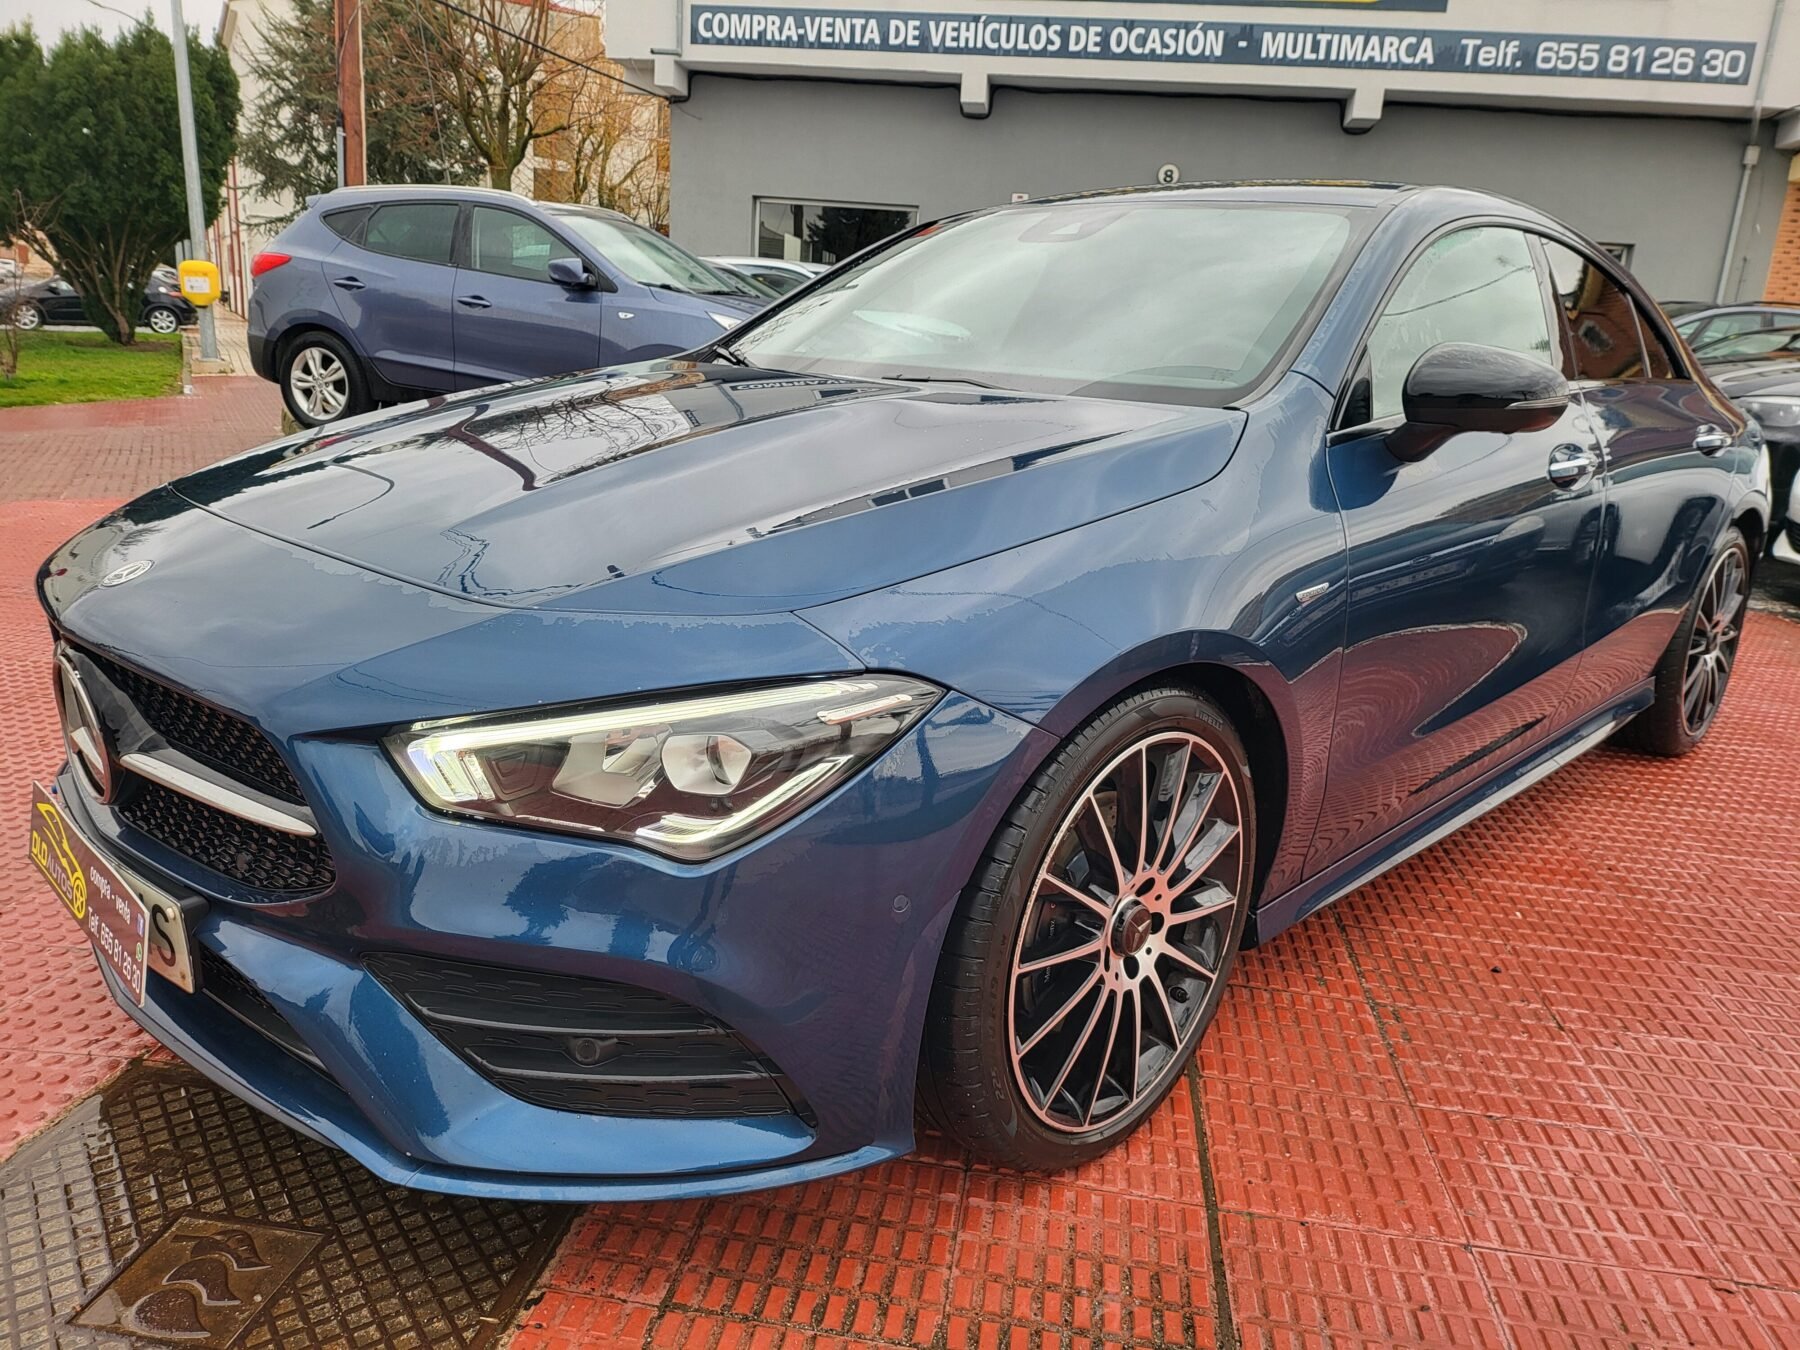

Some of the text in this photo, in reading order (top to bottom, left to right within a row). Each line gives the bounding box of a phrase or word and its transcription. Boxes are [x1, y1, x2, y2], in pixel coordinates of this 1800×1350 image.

[698, 11, 880, 45] COMPRA-VENTA
[888, 20, 919, 47] DE
[929, 15, 1061, 52] VEHÍCULOS
[1068, 25, 1101, 53] DE
[1109, 22, 1223, 57] OCASIÓN
[1260, 31, 1434, 66] MULTIMARCA
[1461, 37, 1523, 69] Telf.
[1535, 41, 1599, 72] 655
[1701, 49, 1746, 78] 30
[1163, 169, 1173, 183] 8
[90, 866, 111, 900] compra
